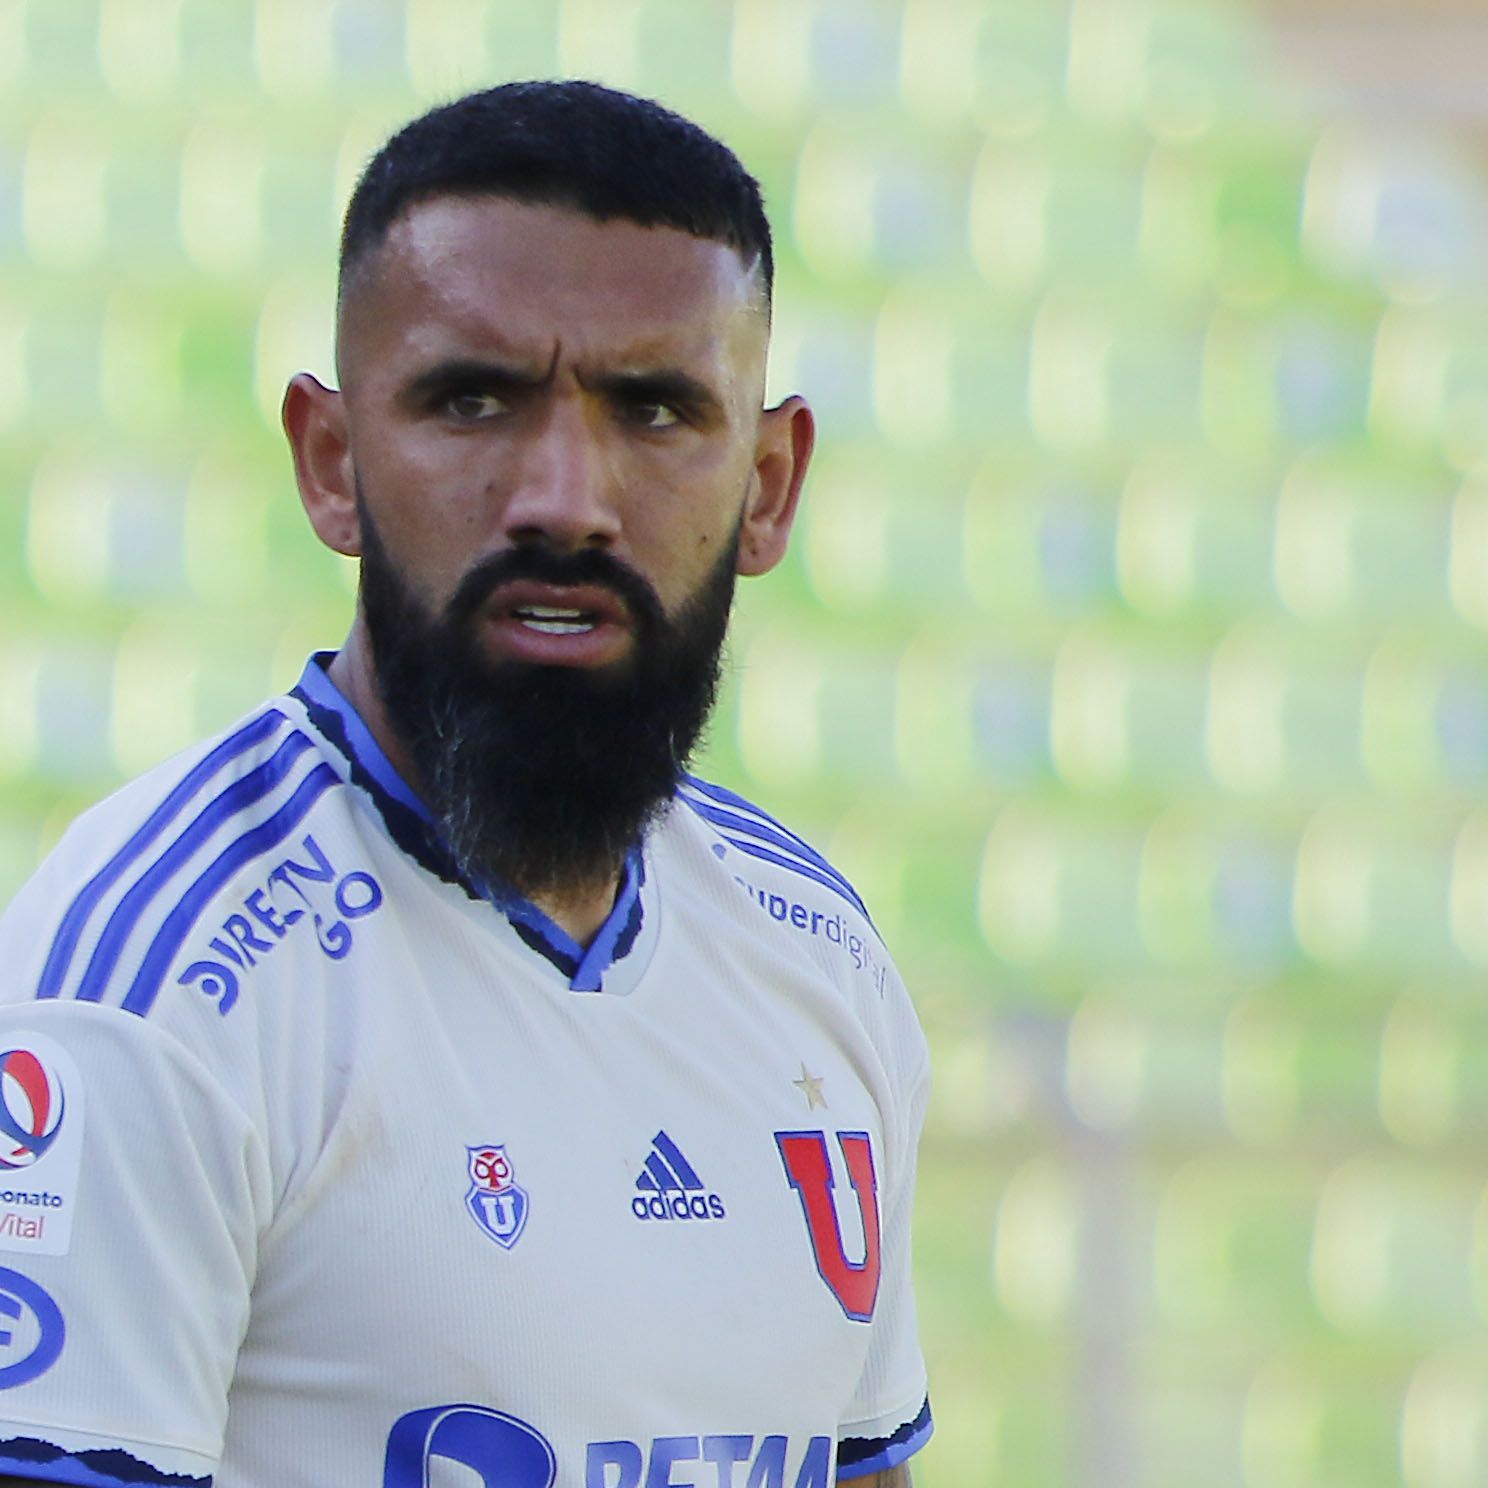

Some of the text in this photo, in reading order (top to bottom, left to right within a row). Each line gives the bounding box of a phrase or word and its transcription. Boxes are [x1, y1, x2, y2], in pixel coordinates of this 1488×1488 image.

[313, 870, 383, 960] GO
[480, 1195, 516, 1237] U
[631, 1193, 725, 1221] adidas
[773, 1129, 882, 1324] U
